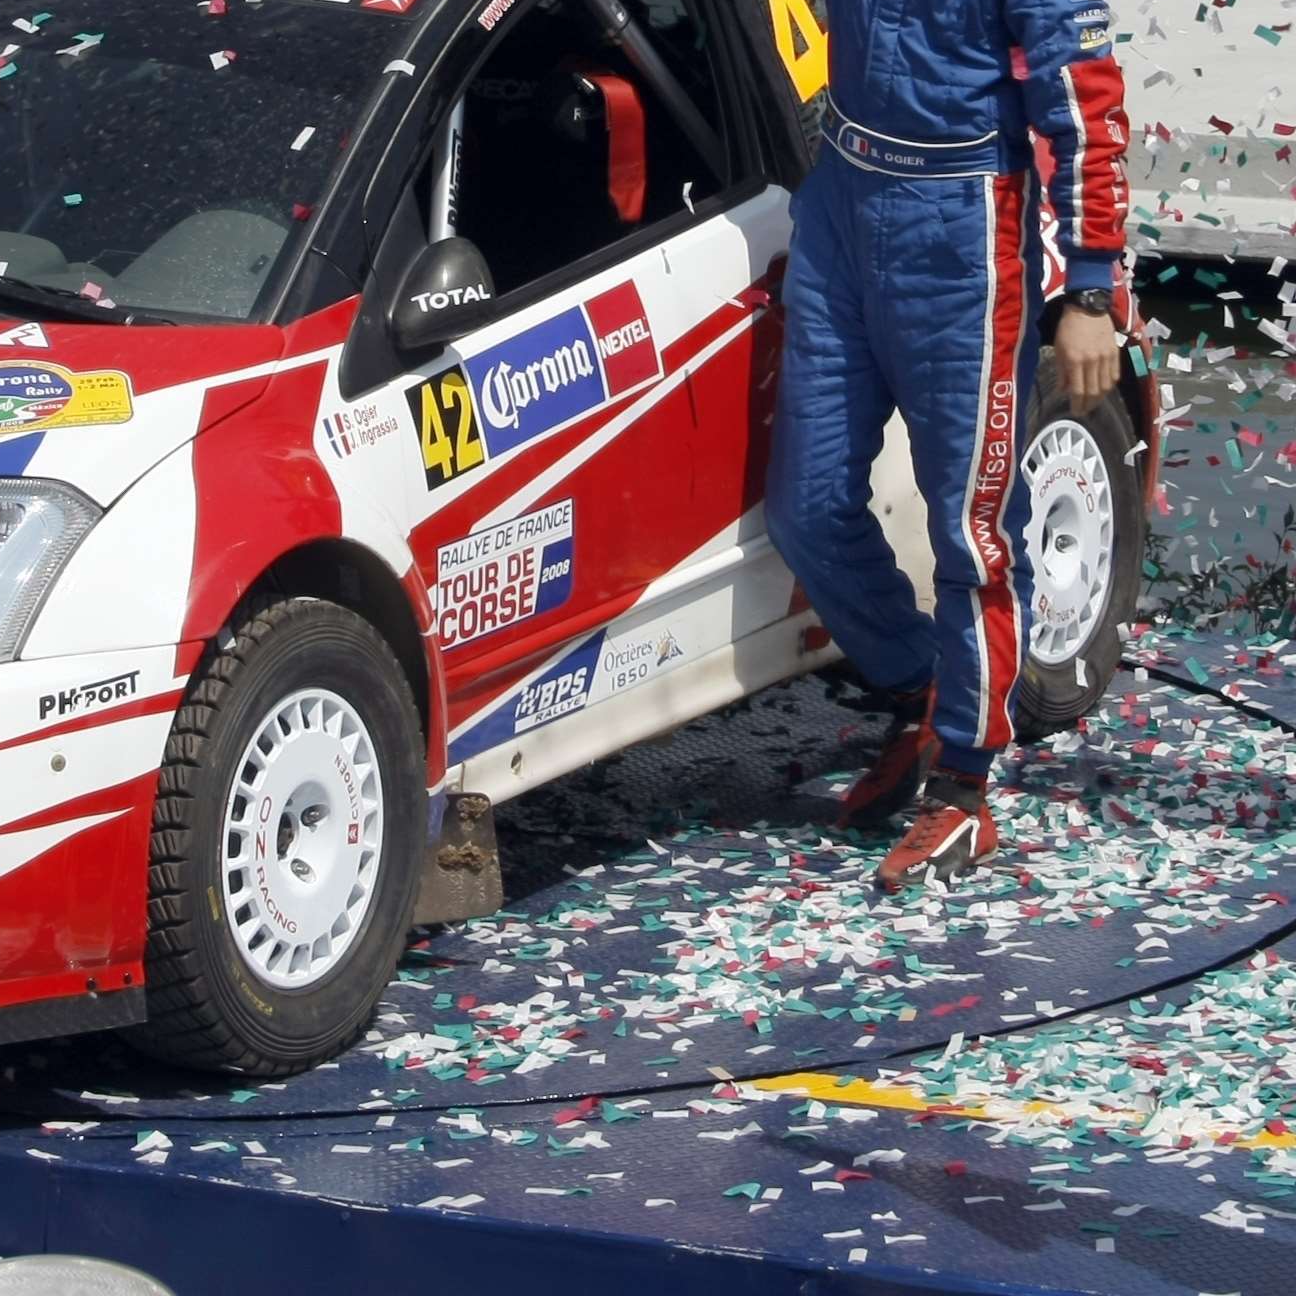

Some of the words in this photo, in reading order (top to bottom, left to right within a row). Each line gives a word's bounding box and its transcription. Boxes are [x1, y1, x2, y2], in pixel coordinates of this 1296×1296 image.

[885, 152, 925, 166] OGIER
[411, 284, 492, 314] TOTAL
[601, 318, 650, 359] NEXTEL
[25, 386, 64, 397] Rally
[481, 337, 594, 430] Corona
[354, 404, 377, 427] Ogier
[358, 415, 399, 445] Ingrassia
[421, 372, 486, 479] 42
[975, 380, 1013, 564] www.ffsa.org
[439, 533, 491, 571] RALLYE
[495, 525, 513, 551] DE
[516, 504, 571, 544] FRANCE
[439, 559, 499, 608] TOUR
[507, 547, 535, 584] DE
[540, 558, 571, 584] 2008
[438, 577, 534, 648] CORSE
[603, 639, 653, 673] Orcières
[537, 667, 588, 712] BPS
[610, 663, 648, 692] 1850
[534, 697, 583, 723] RALLYE
[256, 866, 298, 934] RACING
